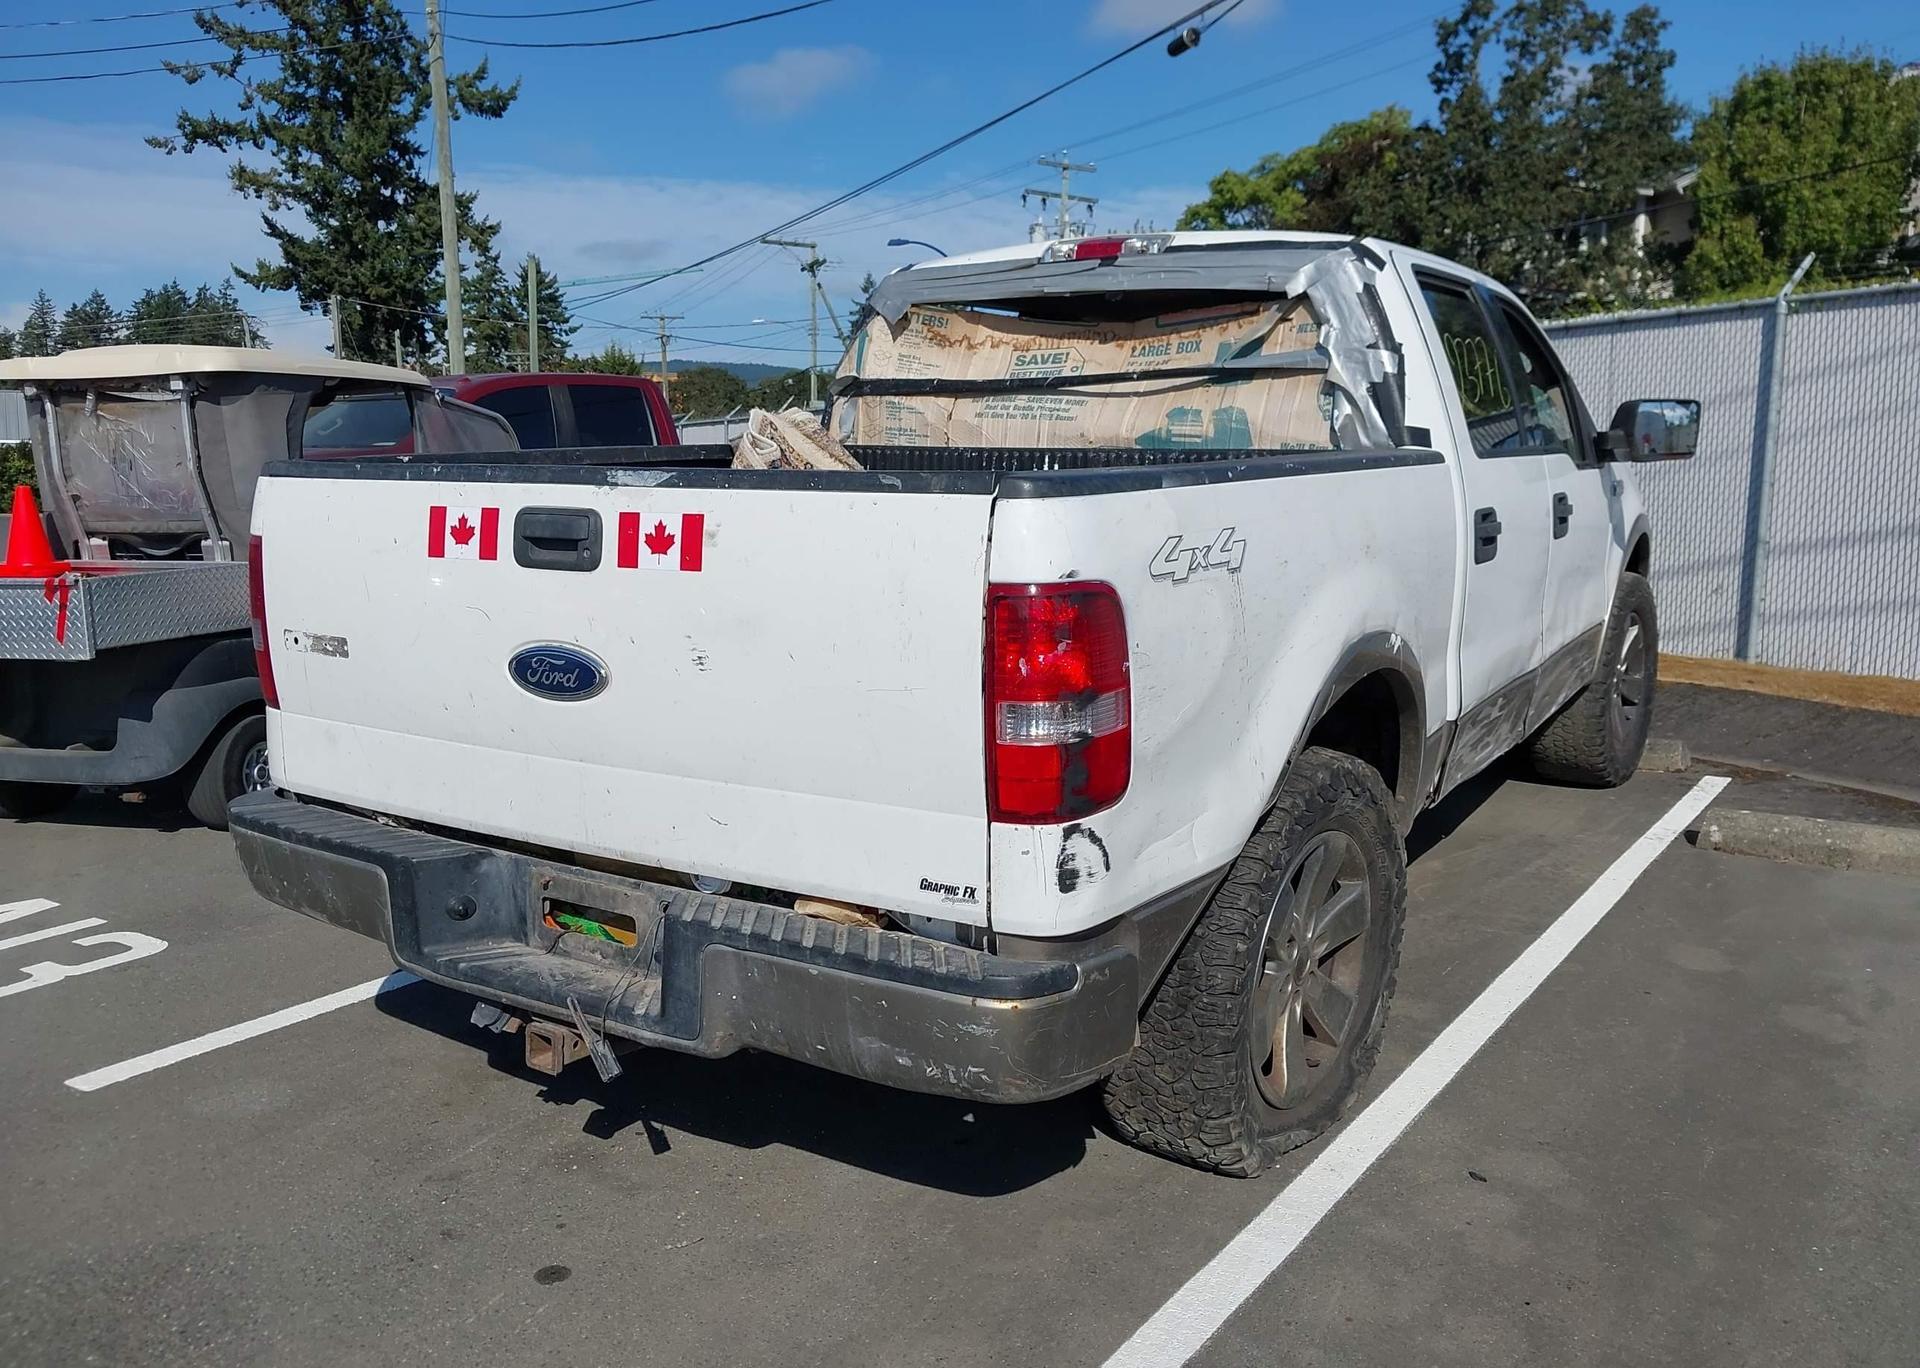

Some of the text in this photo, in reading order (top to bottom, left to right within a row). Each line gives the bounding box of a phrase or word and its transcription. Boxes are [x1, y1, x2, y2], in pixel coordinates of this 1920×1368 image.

[1013, 351, 1071, 367] SAVE!
[1130, 339, 1203, 358] LARGE BOX
[1009, 368, 1064, 379] BEST PRICE
[1149, 526, 1246, 584] 4x4
[527, 656, 580, 688] Ford
[919, 877, 978, 900] GRAPHIC FX
